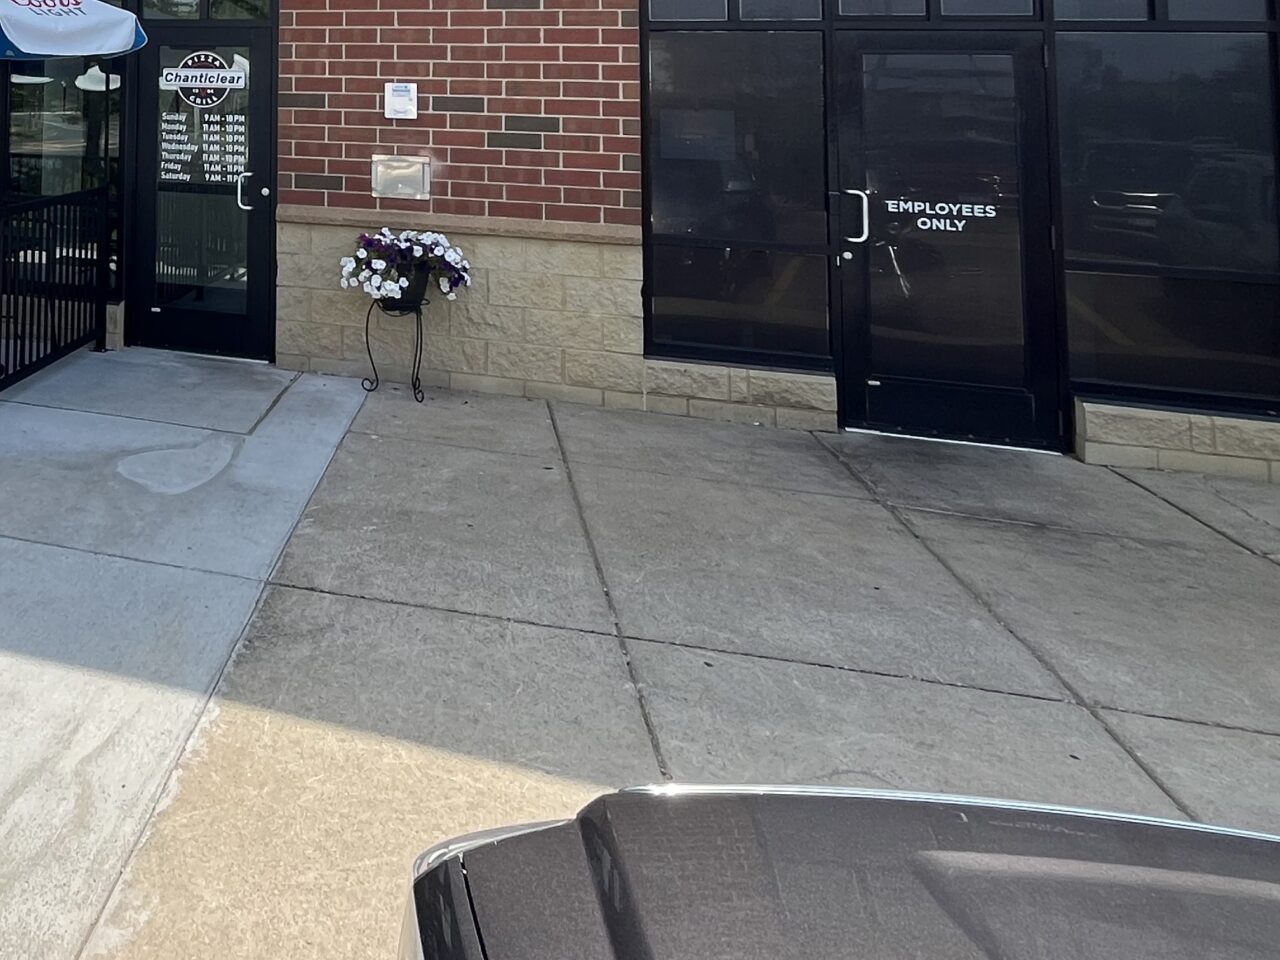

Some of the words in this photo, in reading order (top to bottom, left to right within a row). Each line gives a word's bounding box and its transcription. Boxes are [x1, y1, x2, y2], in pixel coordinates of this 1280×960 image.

[27, 6, 89, 17] LIGHT
[186, 54, 220, 67] PIZZA
[164, 72, 242, 84] Chanticlear
[189, 95, 218, 105] GRILL
[886, 200, 997, 218] EMPLOYEES
[916, 217, 967, 232] ONLY
